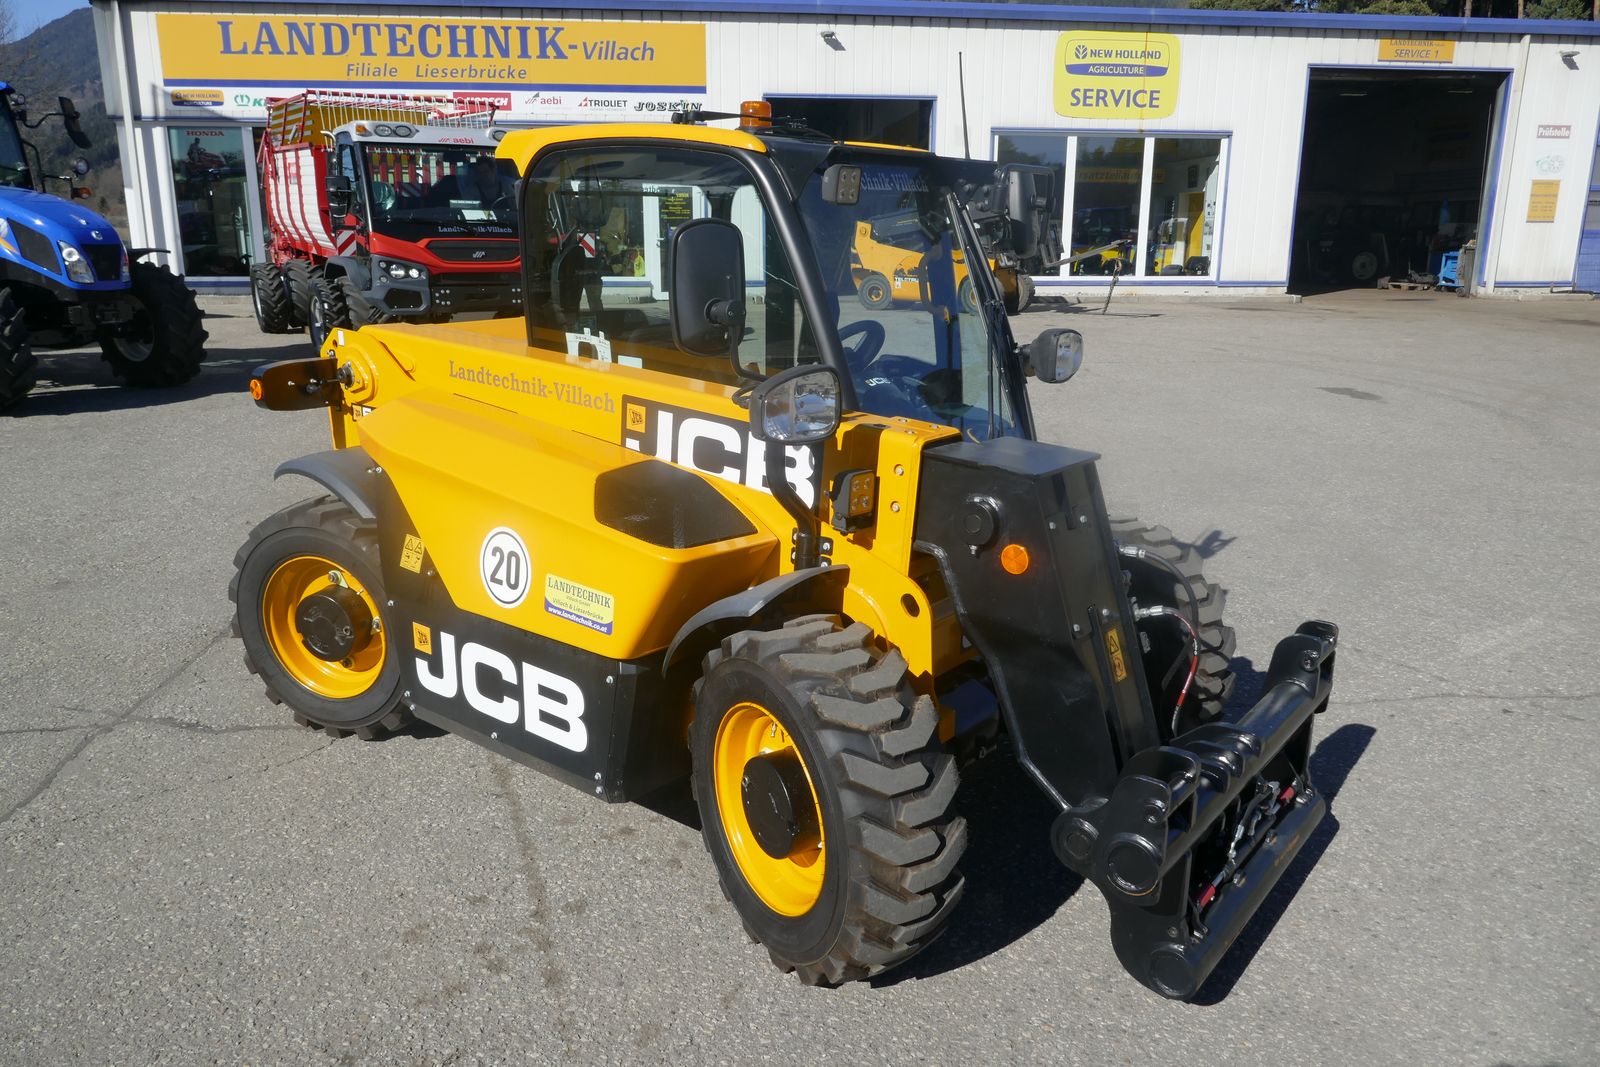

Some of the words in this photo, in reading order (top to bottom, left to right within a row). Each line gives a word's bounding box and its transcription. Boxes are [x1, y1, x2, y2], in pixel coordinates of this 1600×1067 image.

[1090, 49, 1113, 58] NEW
[1115, 50, 1161, 60] HOLLAND
[1394, 48, 1431, 58] SERVICE
[1434, 50, 1439, 58] 1
[346, 63, 398, 77] Filiale
[416, 64, 527, 80] Lieserbrücke
[1088, 66, 1144, 74] AGRICULTURE
[540, 96, 562, 104] aebi
[634, 101, 702, 111] JOSKIN
[1070, 88, 1160, 108] SERVICE
[1537, 127, 1570, 137] Prüfstelle
[449, 360, 615, 413] Landtechnik-Villach
[490, 546, 521, 591] 20
[547, 576, 611, 609] LANDTECHNIK
[548, 606, 608, 633] www.landtechnik.co.at
[415, 631, 588, 752] JCB
